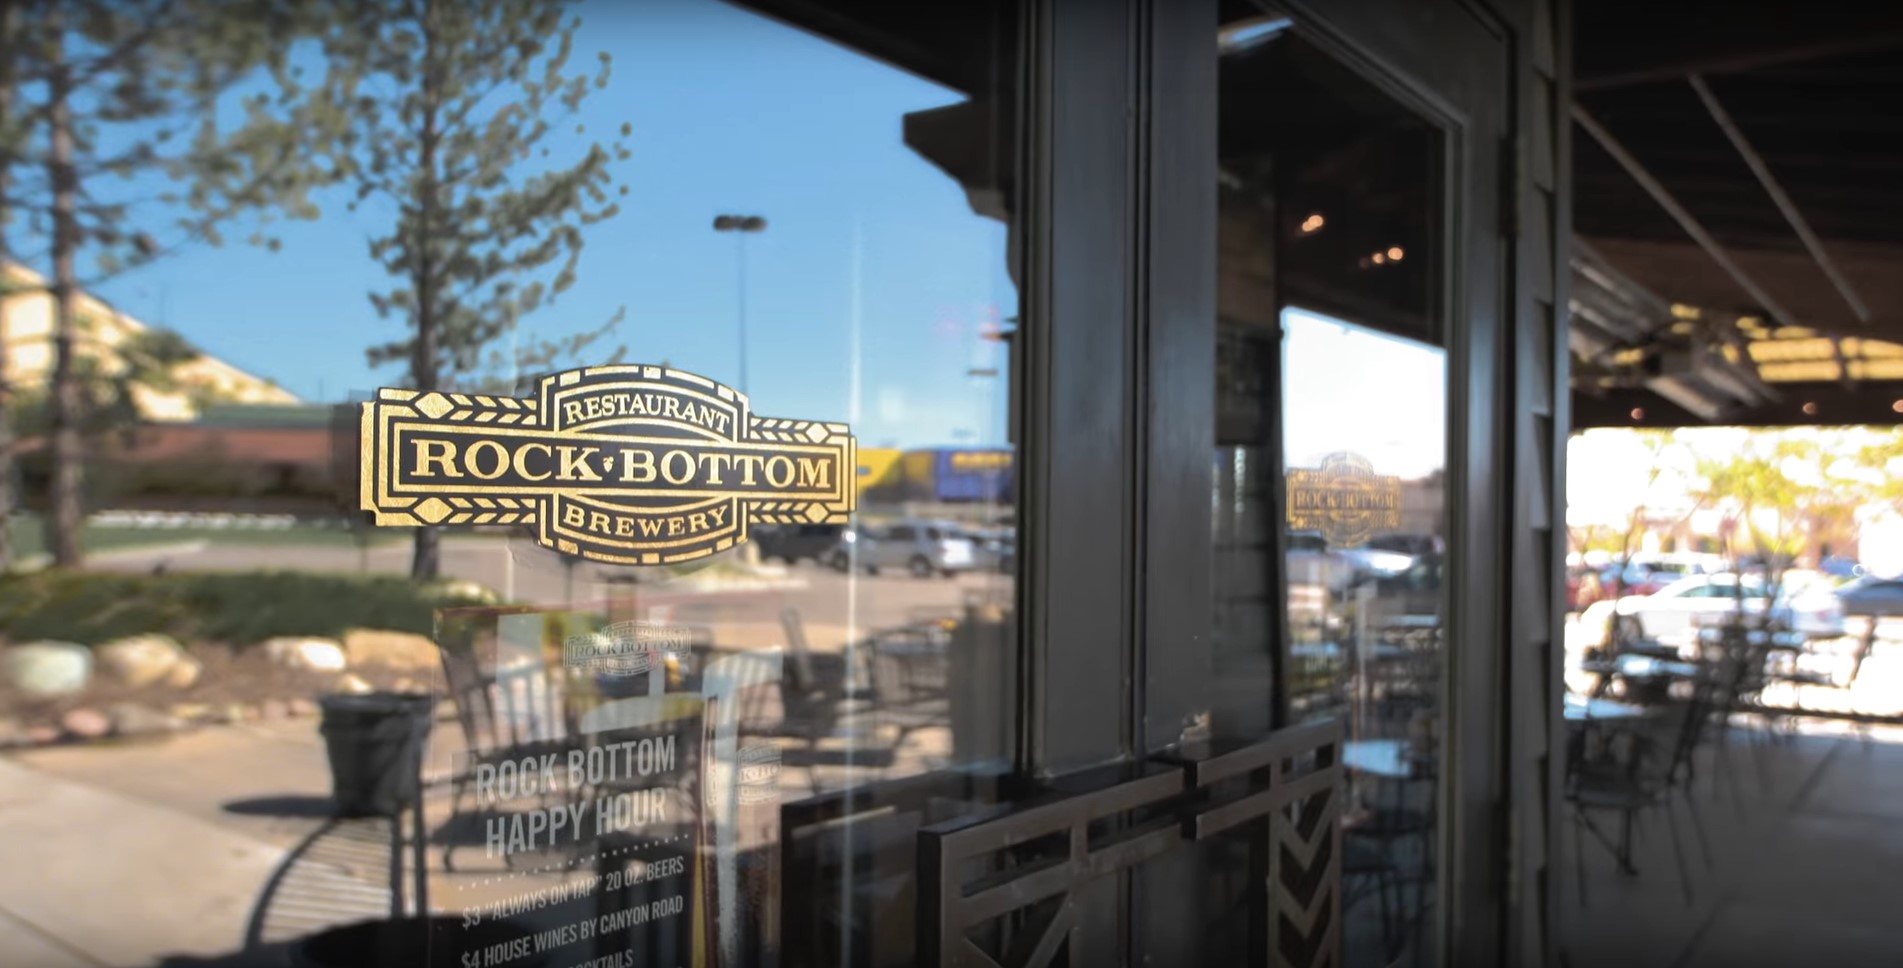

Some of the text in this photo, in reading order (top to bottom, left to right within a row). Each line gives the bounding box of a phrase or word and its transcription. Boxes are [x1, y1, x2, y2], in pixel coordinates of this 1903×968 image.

[563, 394, 730, 434] RESTAURANT
[409, 438, 832, 489] ROCK BOTTOM
[563, 503, 728, 538] BREWERY
[476, 735, 676, 806] ROCK BOTTOM
[485, 787, 667, 860] HAPPY HOUR
[462, 906, 482, 931] $3
[550, 884, 569, 907] ON
[606, 871, 622, 893] 20
[624, 864, 644, 886] OZ.
[646, 855, 685, 881] BEERS
[461, 894, 684, 968] $4 HOUSE WINES BY CANYON ROAD
[568, 949, 634, 968] CKTAILS
